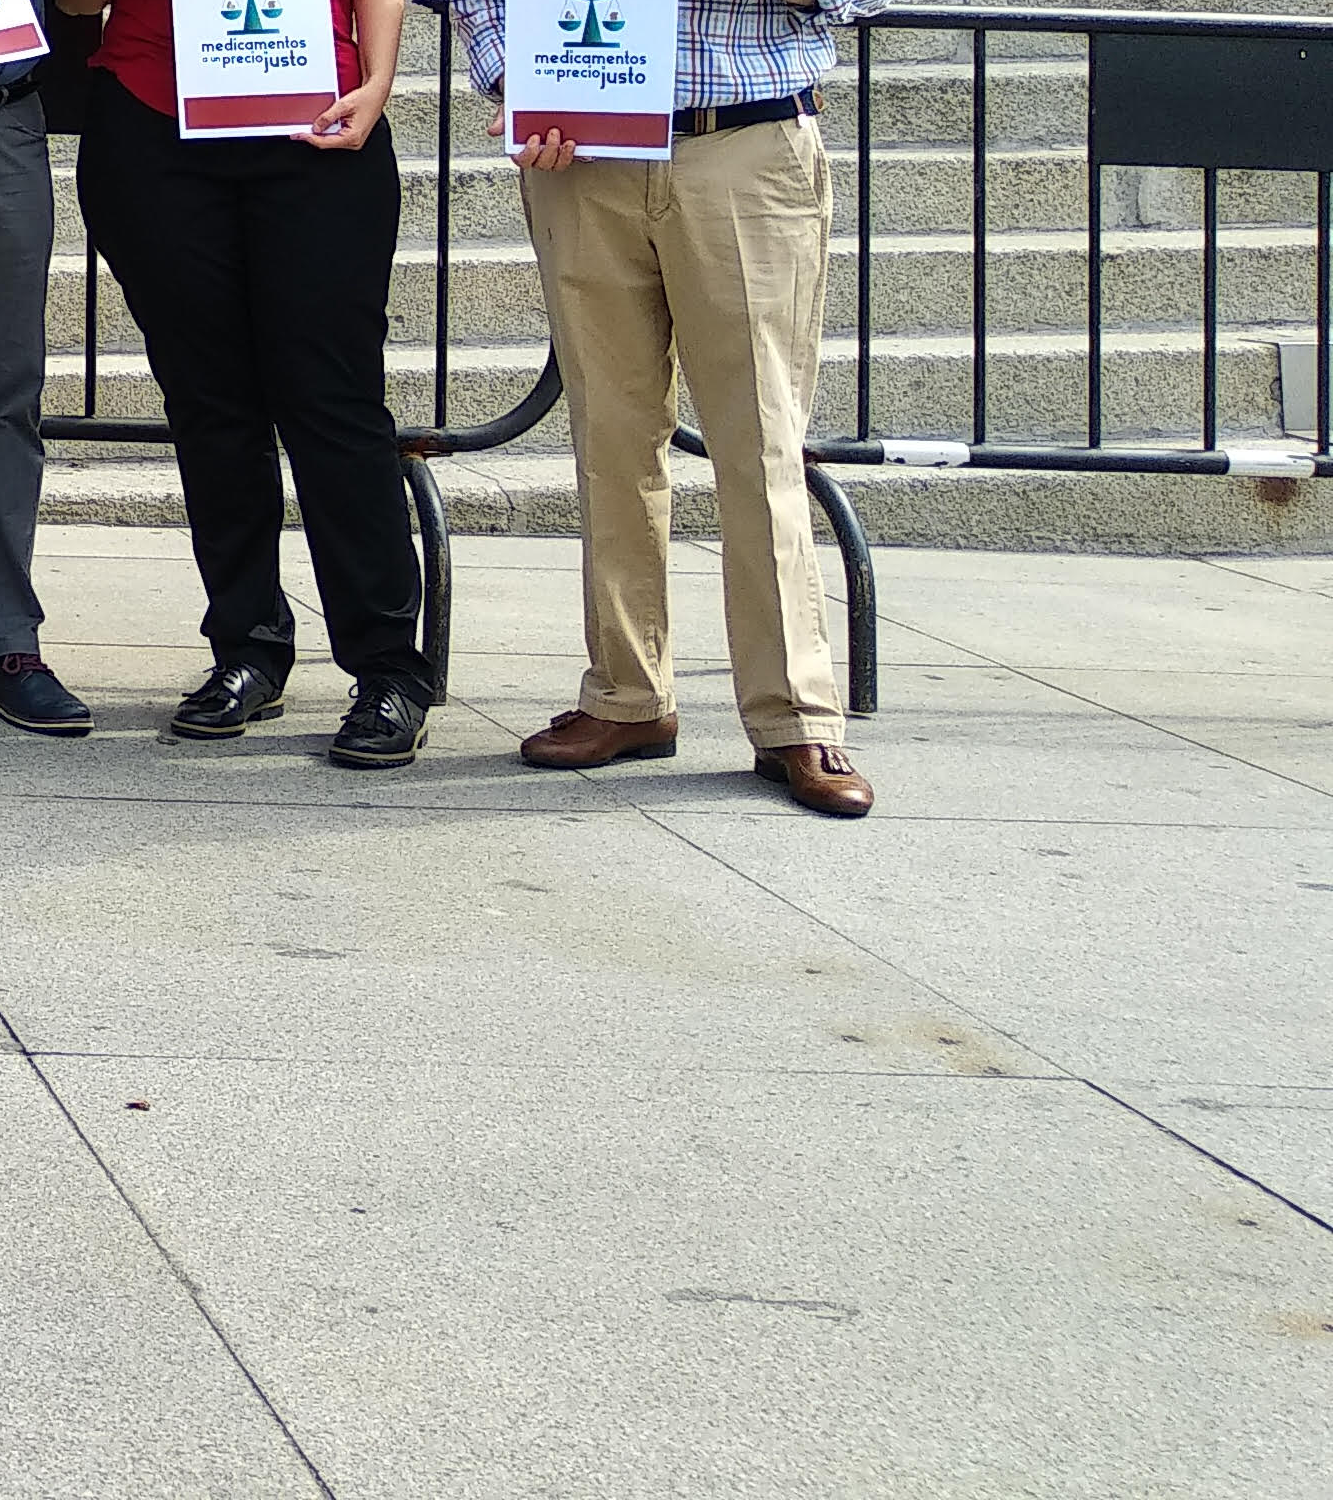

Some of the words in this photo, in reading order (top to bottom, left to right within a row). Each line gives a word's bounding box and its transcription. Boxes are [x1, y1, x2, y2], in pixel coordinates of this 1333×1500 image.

[201, 36, 307, 52] medicamentos
[222, 51, 263, 68] precio
[264, 50, 308, 73] justo
[534, 50, 647, 65] medicamentos
[557, 65, 601, 82] precio
[600, 66, 646, 90] justo
